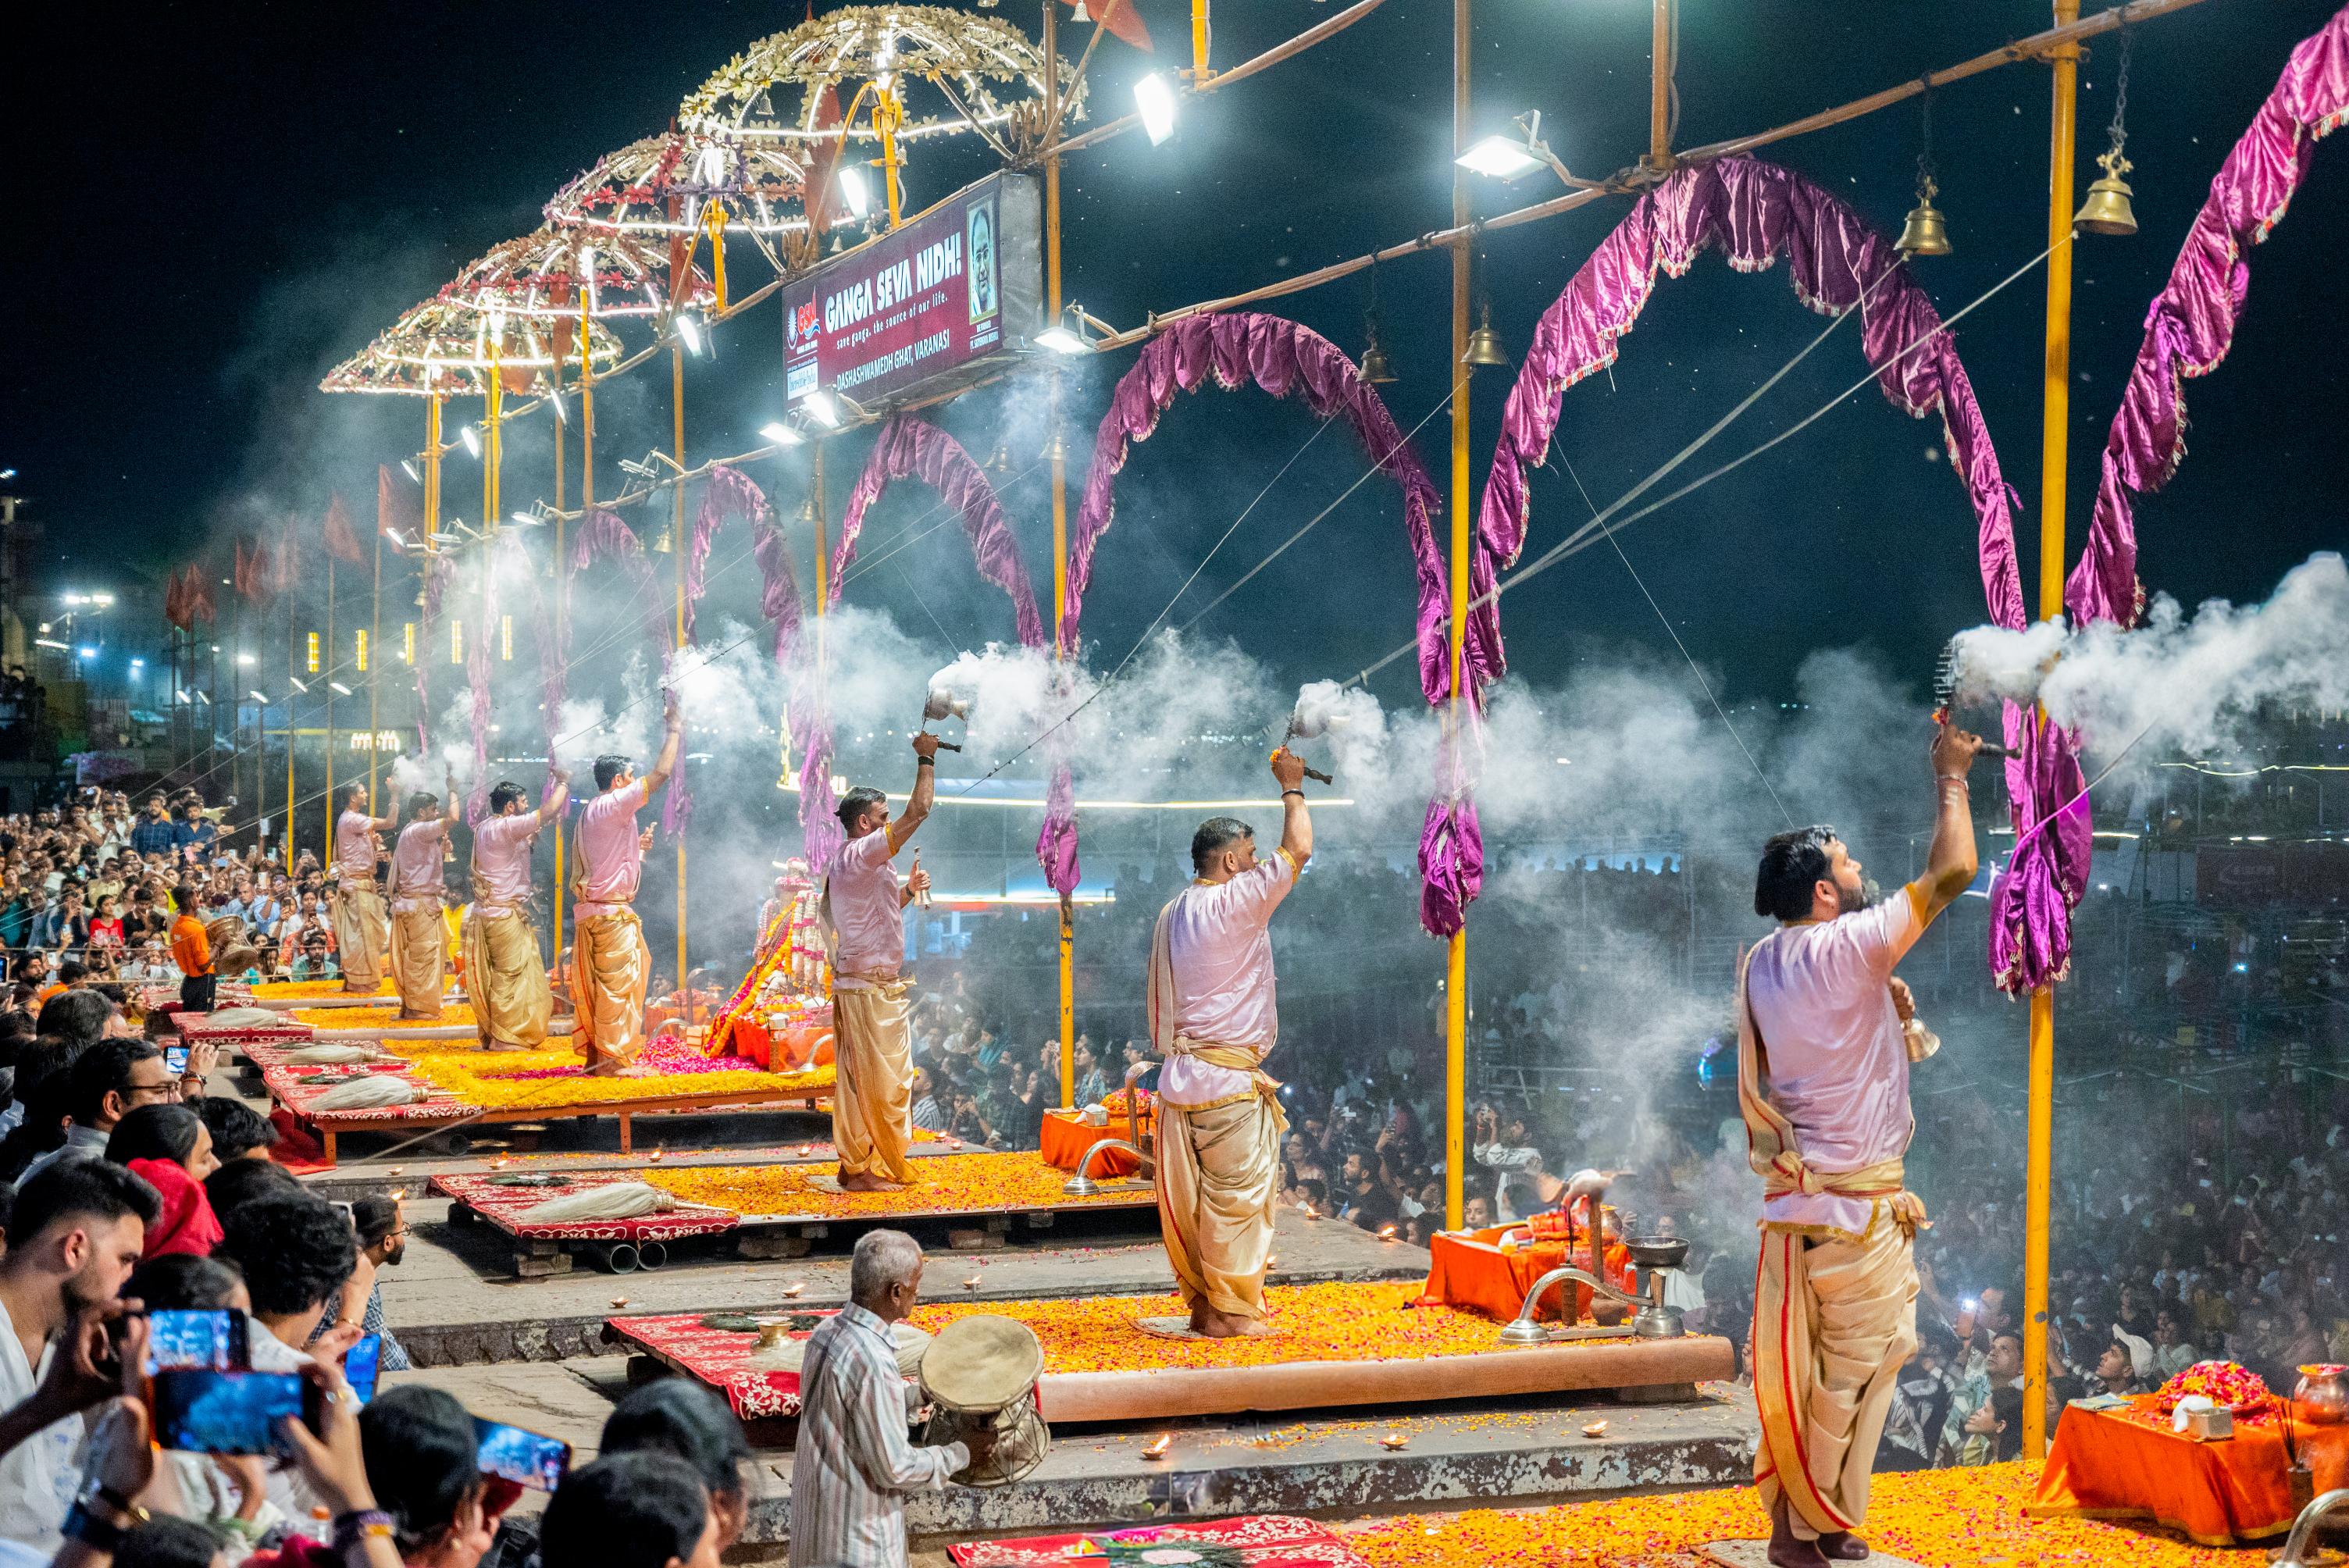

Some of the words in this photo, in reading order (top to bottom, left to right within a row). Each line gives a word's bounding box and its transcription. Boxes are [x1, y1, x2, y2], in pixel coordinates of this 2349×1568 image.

[825, 278, 874, 334] GANGA
[876, 258, 913, 311] SEVA
[836, 336, 850, 350] save
[873, 319, 884, 334] the
[886, 311, 907, 329] source
[909, 302, 916, 318] of
[918, 300, 930, 314] our
[932, 290, 948, 308] life.
[836, 352, 893, 391] DASHASHWAMEDH
[894, 344, 914, 366] GHAT,
[914, 328, 950, 361] VARANASI
